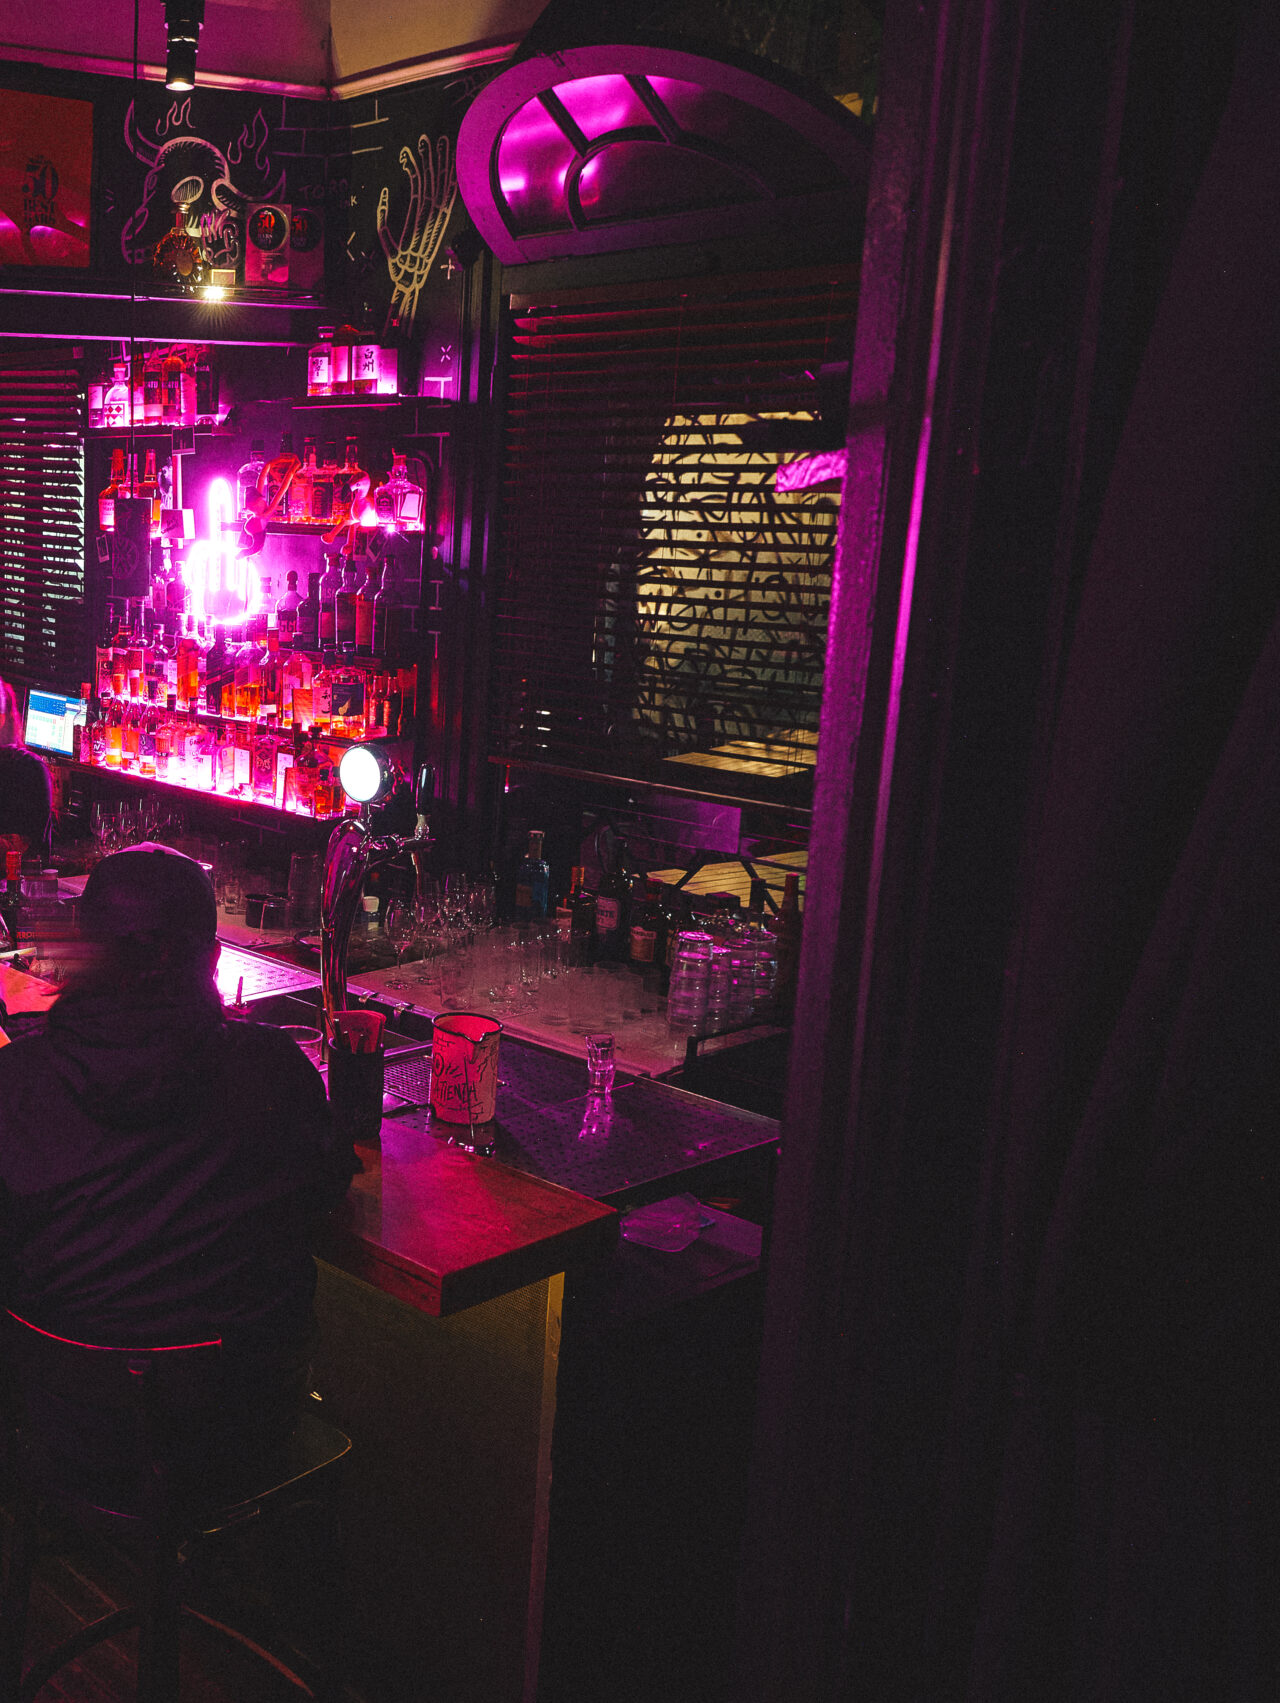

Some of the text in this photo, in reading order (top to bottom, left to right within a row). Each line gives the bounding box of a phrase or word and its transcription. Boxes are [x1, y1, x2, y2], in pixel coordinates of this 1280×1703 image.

[22, 164, 59, 201] 50
[257, 213, 276, 229] 50
[362, 349, 375, 373] 白州
